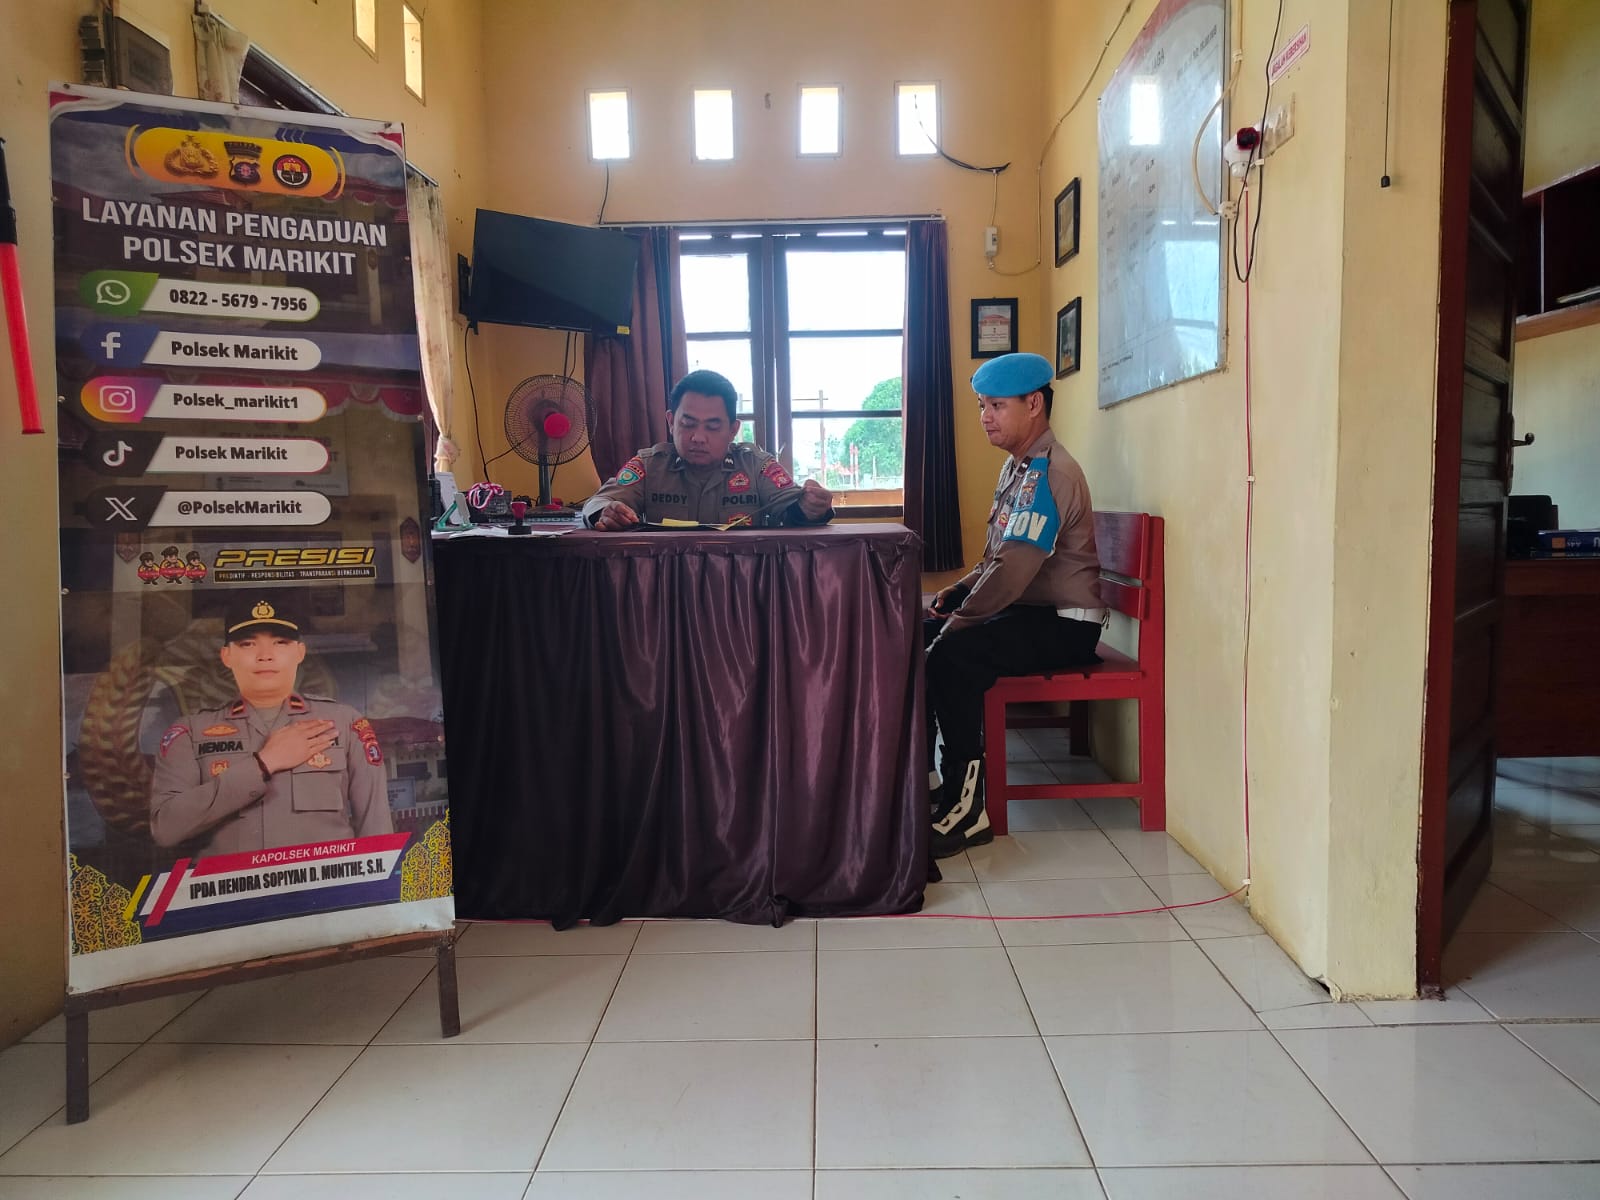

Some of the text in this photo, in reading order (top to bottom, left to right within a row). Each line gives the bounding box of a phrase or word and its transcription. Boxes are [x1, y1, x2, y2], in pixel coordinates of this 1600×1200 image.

[82, 197, 387, 247] LAYANAN PENGADUAN
[123, 235, 356, 275] POLSEK MARIKIT
[169, 289, 208, 306] 0822
[221, 293, 259, 308] 5679
[270, 296, 307, 311] 7956
[171, 341, 299, 361] Polsek Marikit
[173, 392, 299, 410] Polsek_marikit1
[175, 445, 288, 461] Polsek Marikit
[177, 500, 303, 516] @PolsekMarikit
[651, 492, 688, 505] DEDDY
[721, 494, 758, 506] POLRI
[215, 547, 375, 568] PRESISI
[198, 741, 243, 755] HENDRA
[251, 842, 357, 865] KAPOLSEK MARIKIT
[189, 858, 387, 900] IPDA HENDRA SOPIYAN D. MUNTHE, S.H.
